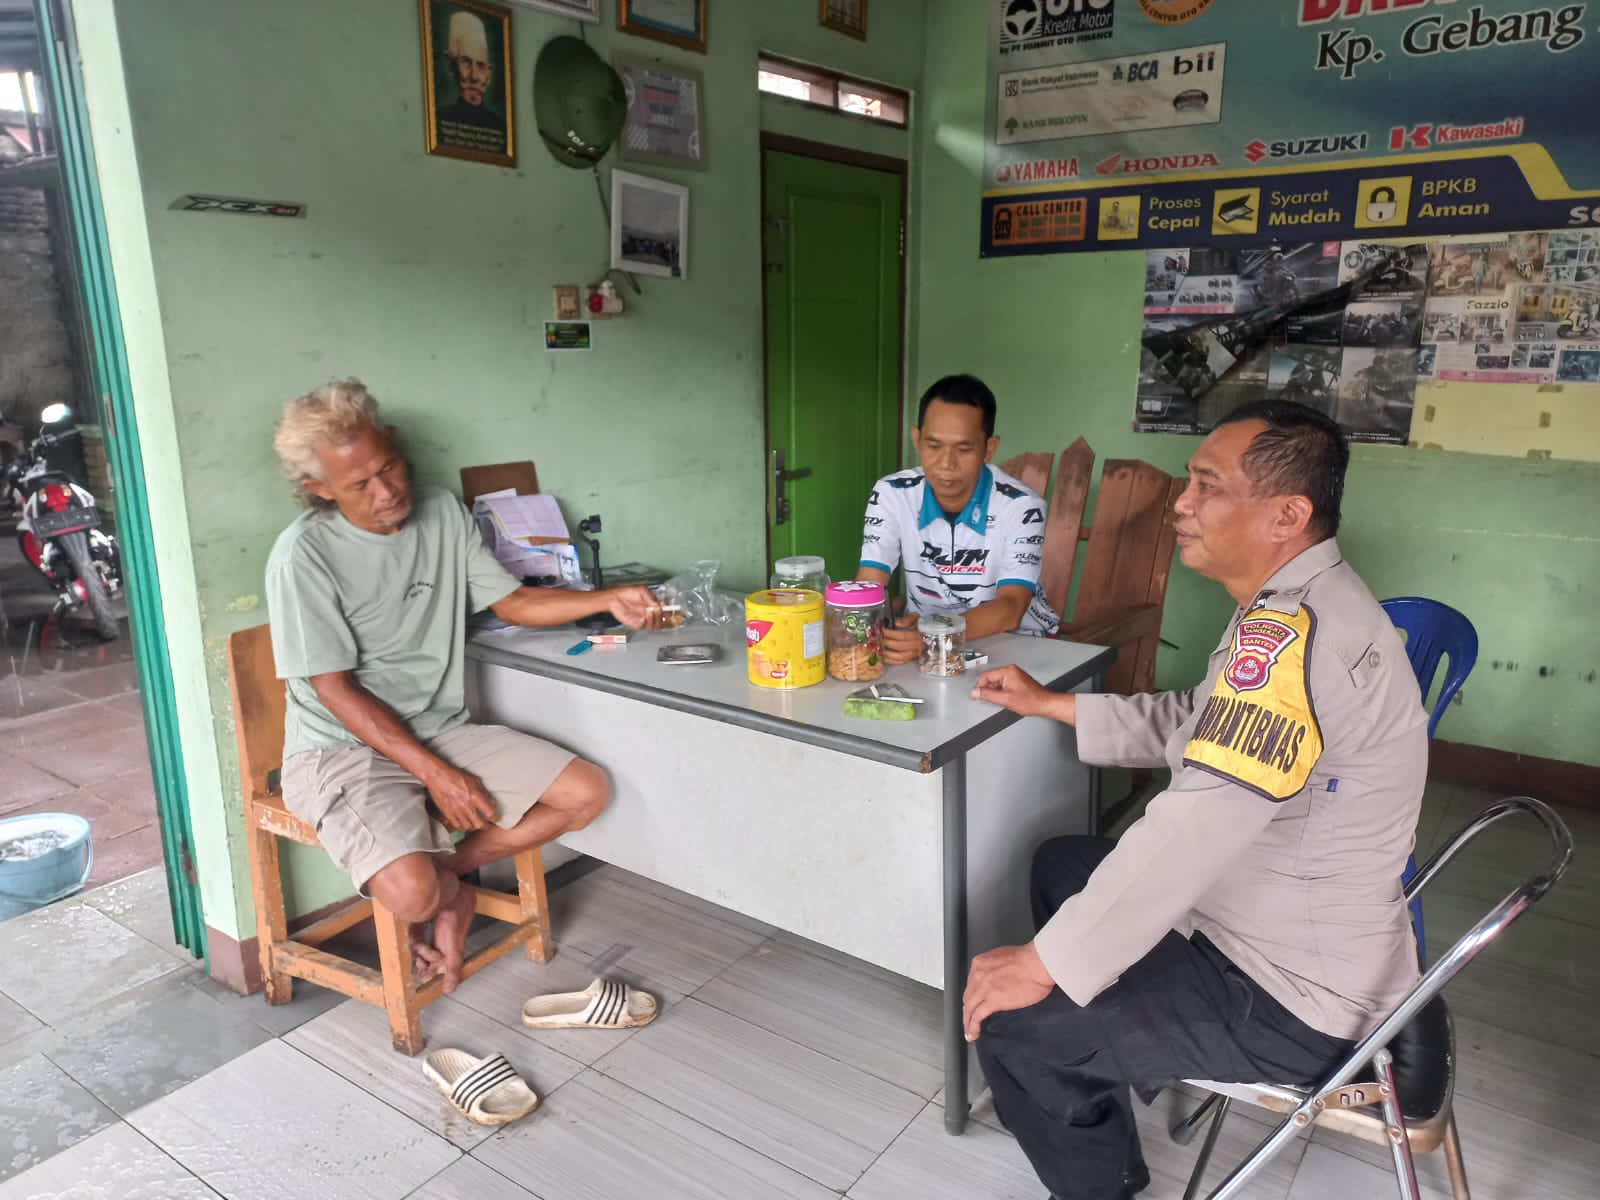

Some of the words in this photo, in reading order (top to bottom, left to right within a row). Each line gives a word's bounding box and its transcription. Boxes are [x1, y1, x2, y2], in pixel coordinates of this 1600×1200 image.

[1044, 17, 1077, 34] Kredit
[1079, 13, 1113, 28] Motor
[1057, 36, 1075, 46] OTO
[1316, 30, 1384, 78] Kp.
[1402, 6, 1585, 55] Gebang
[1127, 60, 1159, 82] BCA
[1173, 51, 1215, 76] bii
[1437, 117, 1523, 143] Kawasaki
[1270, 133, 1367, 157] SUZUKI
[1015, 158, 1079, 180] YAMAHA
[1123, 153, 1219, 172] HONDA
[1422, 178, 1478, 196] BPKB
[1149, 197, 1201, 211] Proses
[1271, 188, 1329, 207] Syarat
[1016, 204, 1040, 217] CALL
[1043, 201, 1082, 214] CENTER
[1268, 209, 1341, 226] Mudah
[1417, 201, 1490, 218] Aman
[1244, 639, 1275, 650] BANTEN
